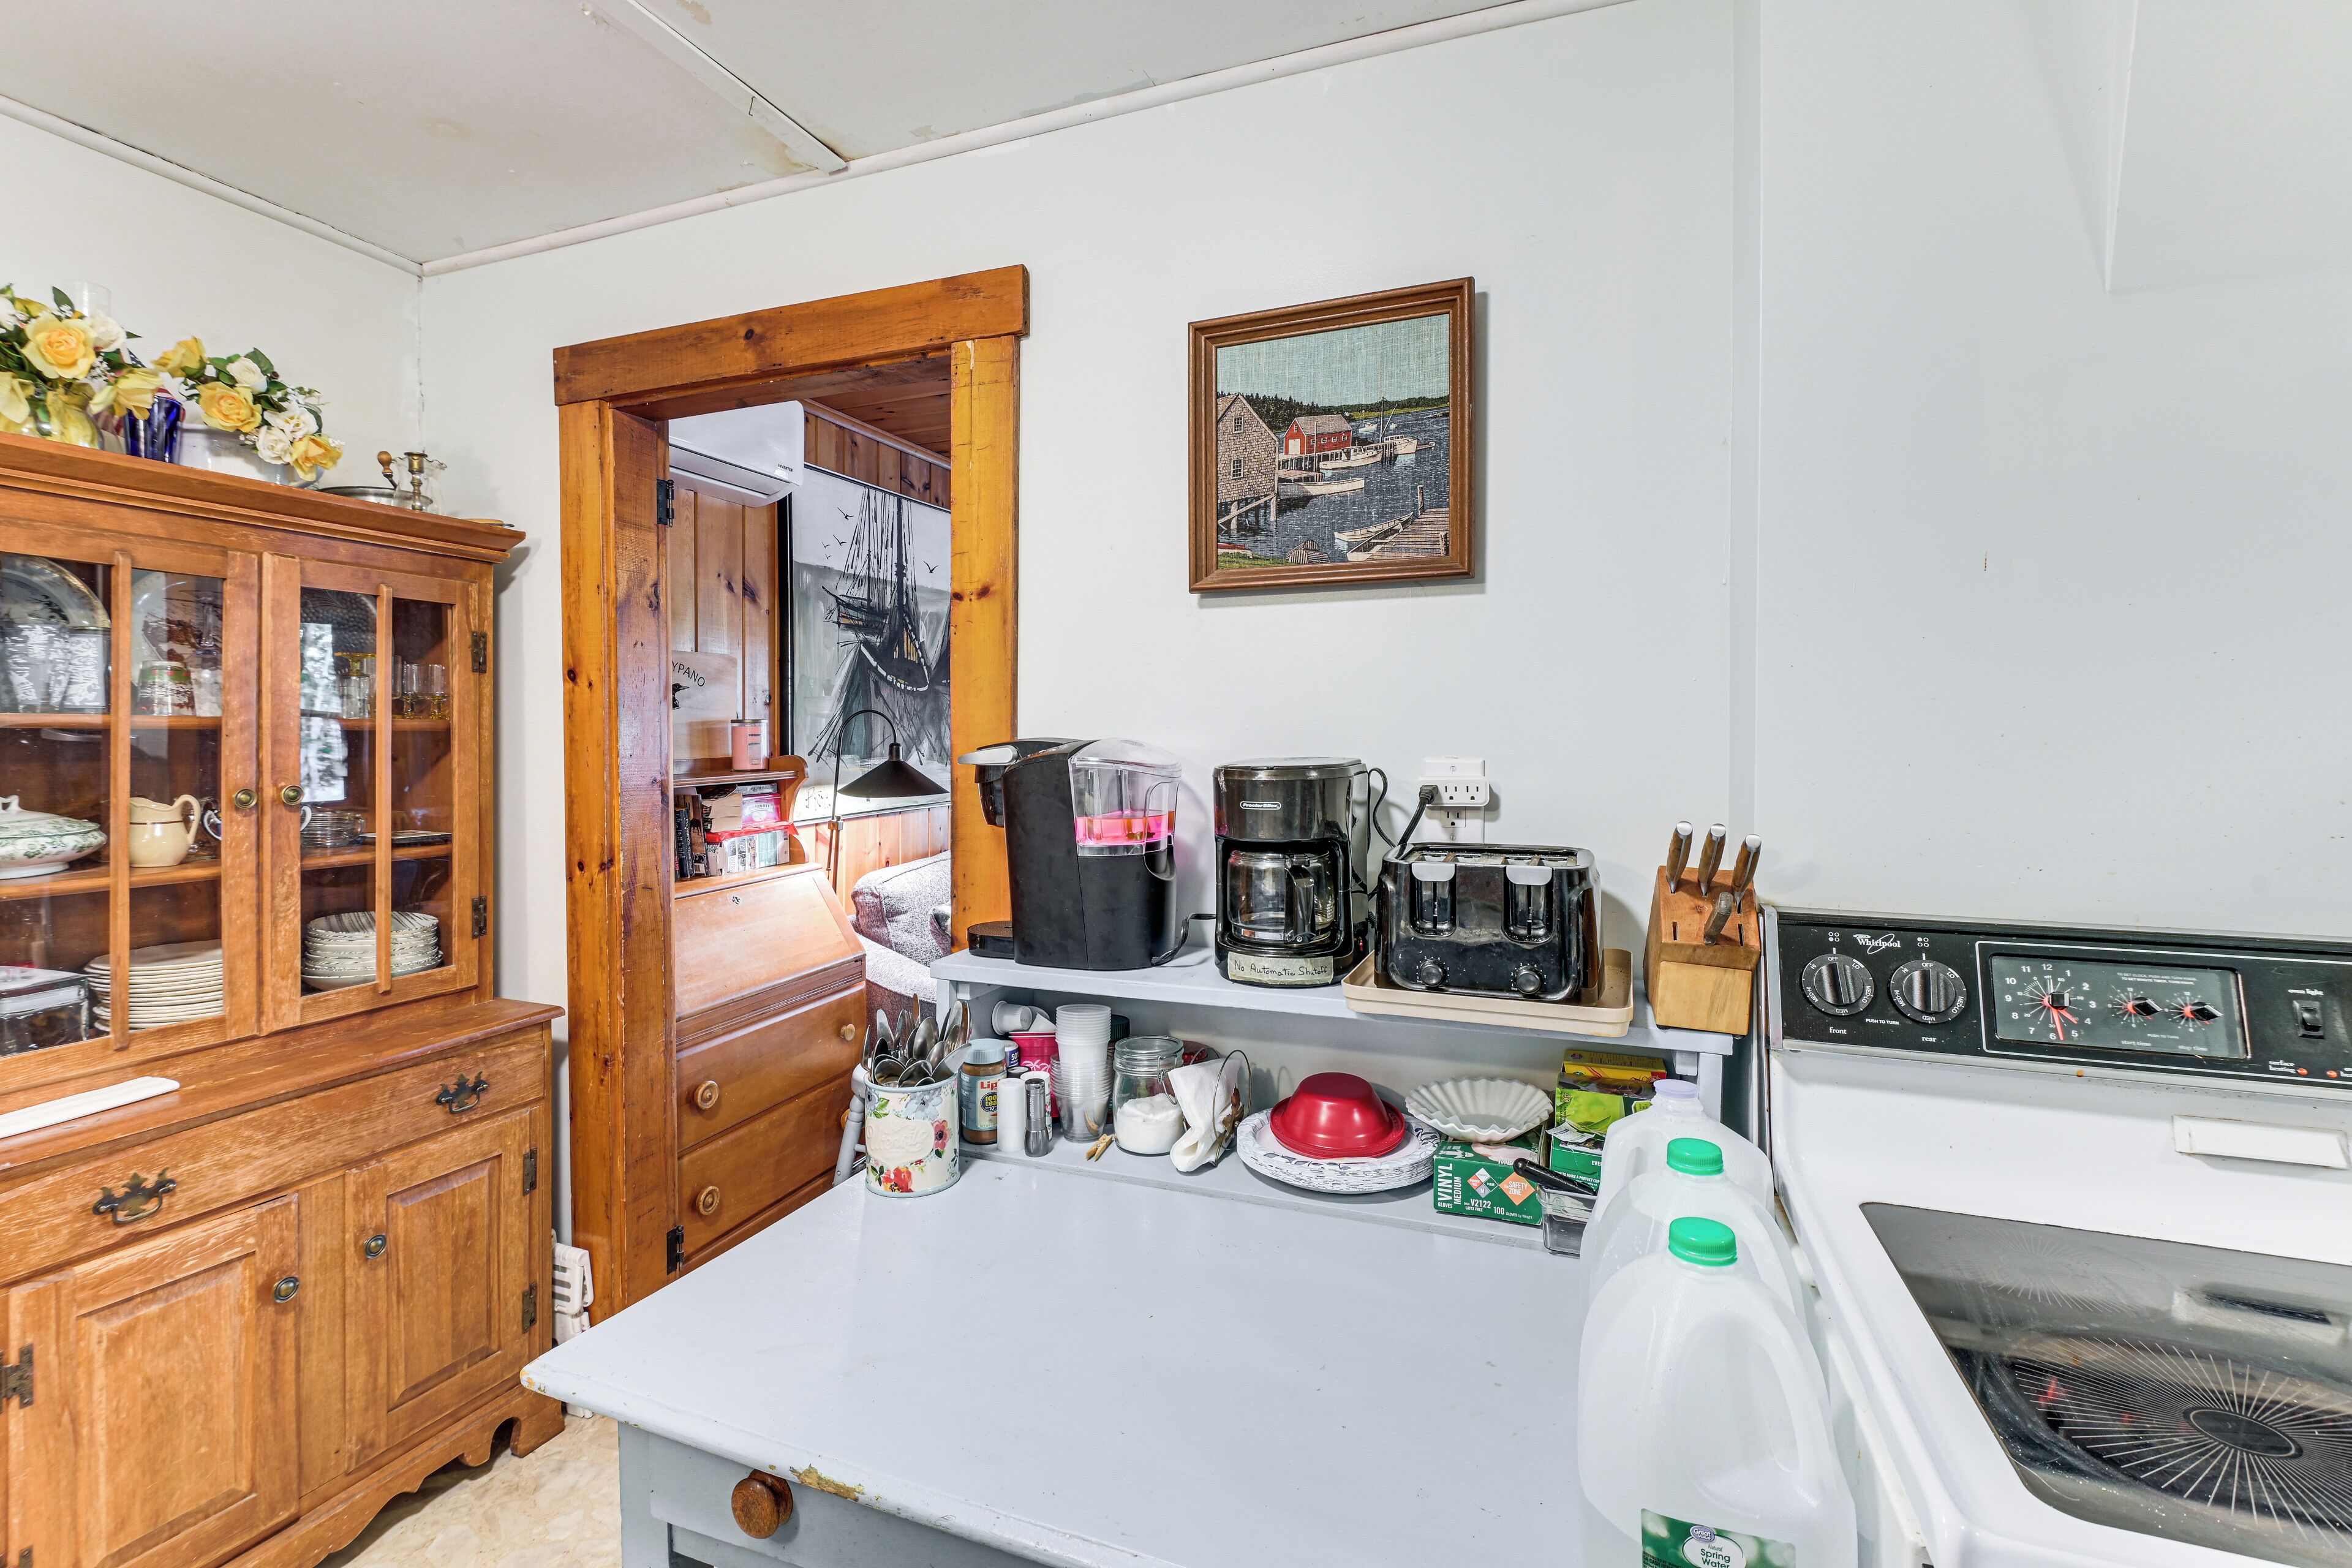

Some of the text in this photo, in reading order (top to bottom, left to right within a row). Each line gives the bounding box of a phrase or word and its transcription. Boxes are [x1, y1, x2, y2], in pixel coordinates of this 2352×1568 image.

[1856, 938, 1901, 949] Whirlpool
[1234, 960, 1328, 977] No Automatic Shutoff
[1806, 986, 1819, 1003] MED-HI
[1861, 986, 1871, 1003] MED-LO
[1894, 989, 1906, 1007] MED-HI
[1951, 996, 1964, 1014] MED-LO
[980, 1080, 999, 1091] Lip
[1563, 1093, 1571, 1102] 40
[1438, 1163, 1453, 1201] VINYL
[1509, 1181, 1528, 1189] SAFETY
[1453, 1177, 1462, 1205] MEDIUM
[1470, 1199, 1491, 1208] V2122
[1493, 1206, 1504, 1215] 100
[1693, 1528, 1711, 1537] Great
[1708, 1544, 1723, 1552] Natural
[1700, 1548, 1731, 1564] Spring
[1702, 1557, 1730, 1568] Water
